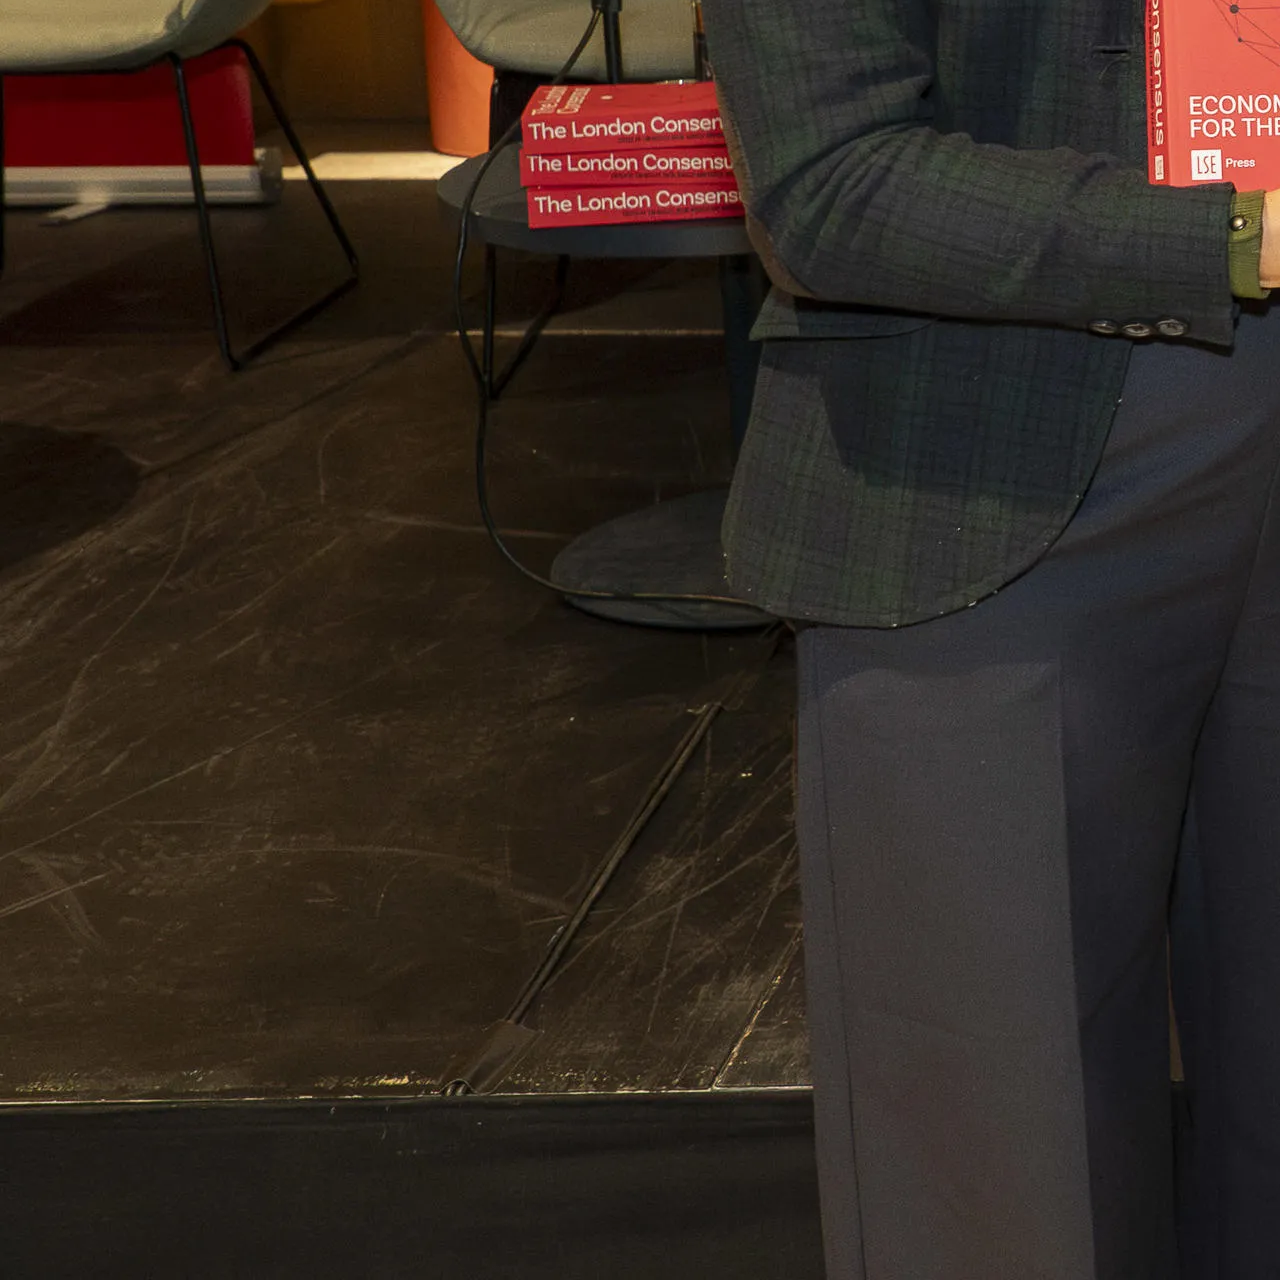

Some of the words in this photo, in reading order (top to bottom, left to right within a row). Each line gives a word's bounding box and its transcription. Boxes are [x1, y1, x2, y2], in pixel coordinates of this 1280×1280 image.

[528, 122, 567, 140] The
[572, 118, 645, 138] London
[651, 116, 723, 133] Consen
[1190, 117, 1237, 138] FOR
[527, 155, 562, 172] The
[567, 153, 638, 172] London
[643, 153, 733, 171] Consensu
[1196, 155, 1217, 175] LSE
[1225, 157, 1256, 169] Press
[534, 196, 572, 213] The
[577, 192, 651, 212] London
[656, 190, 743, 207] Consens
